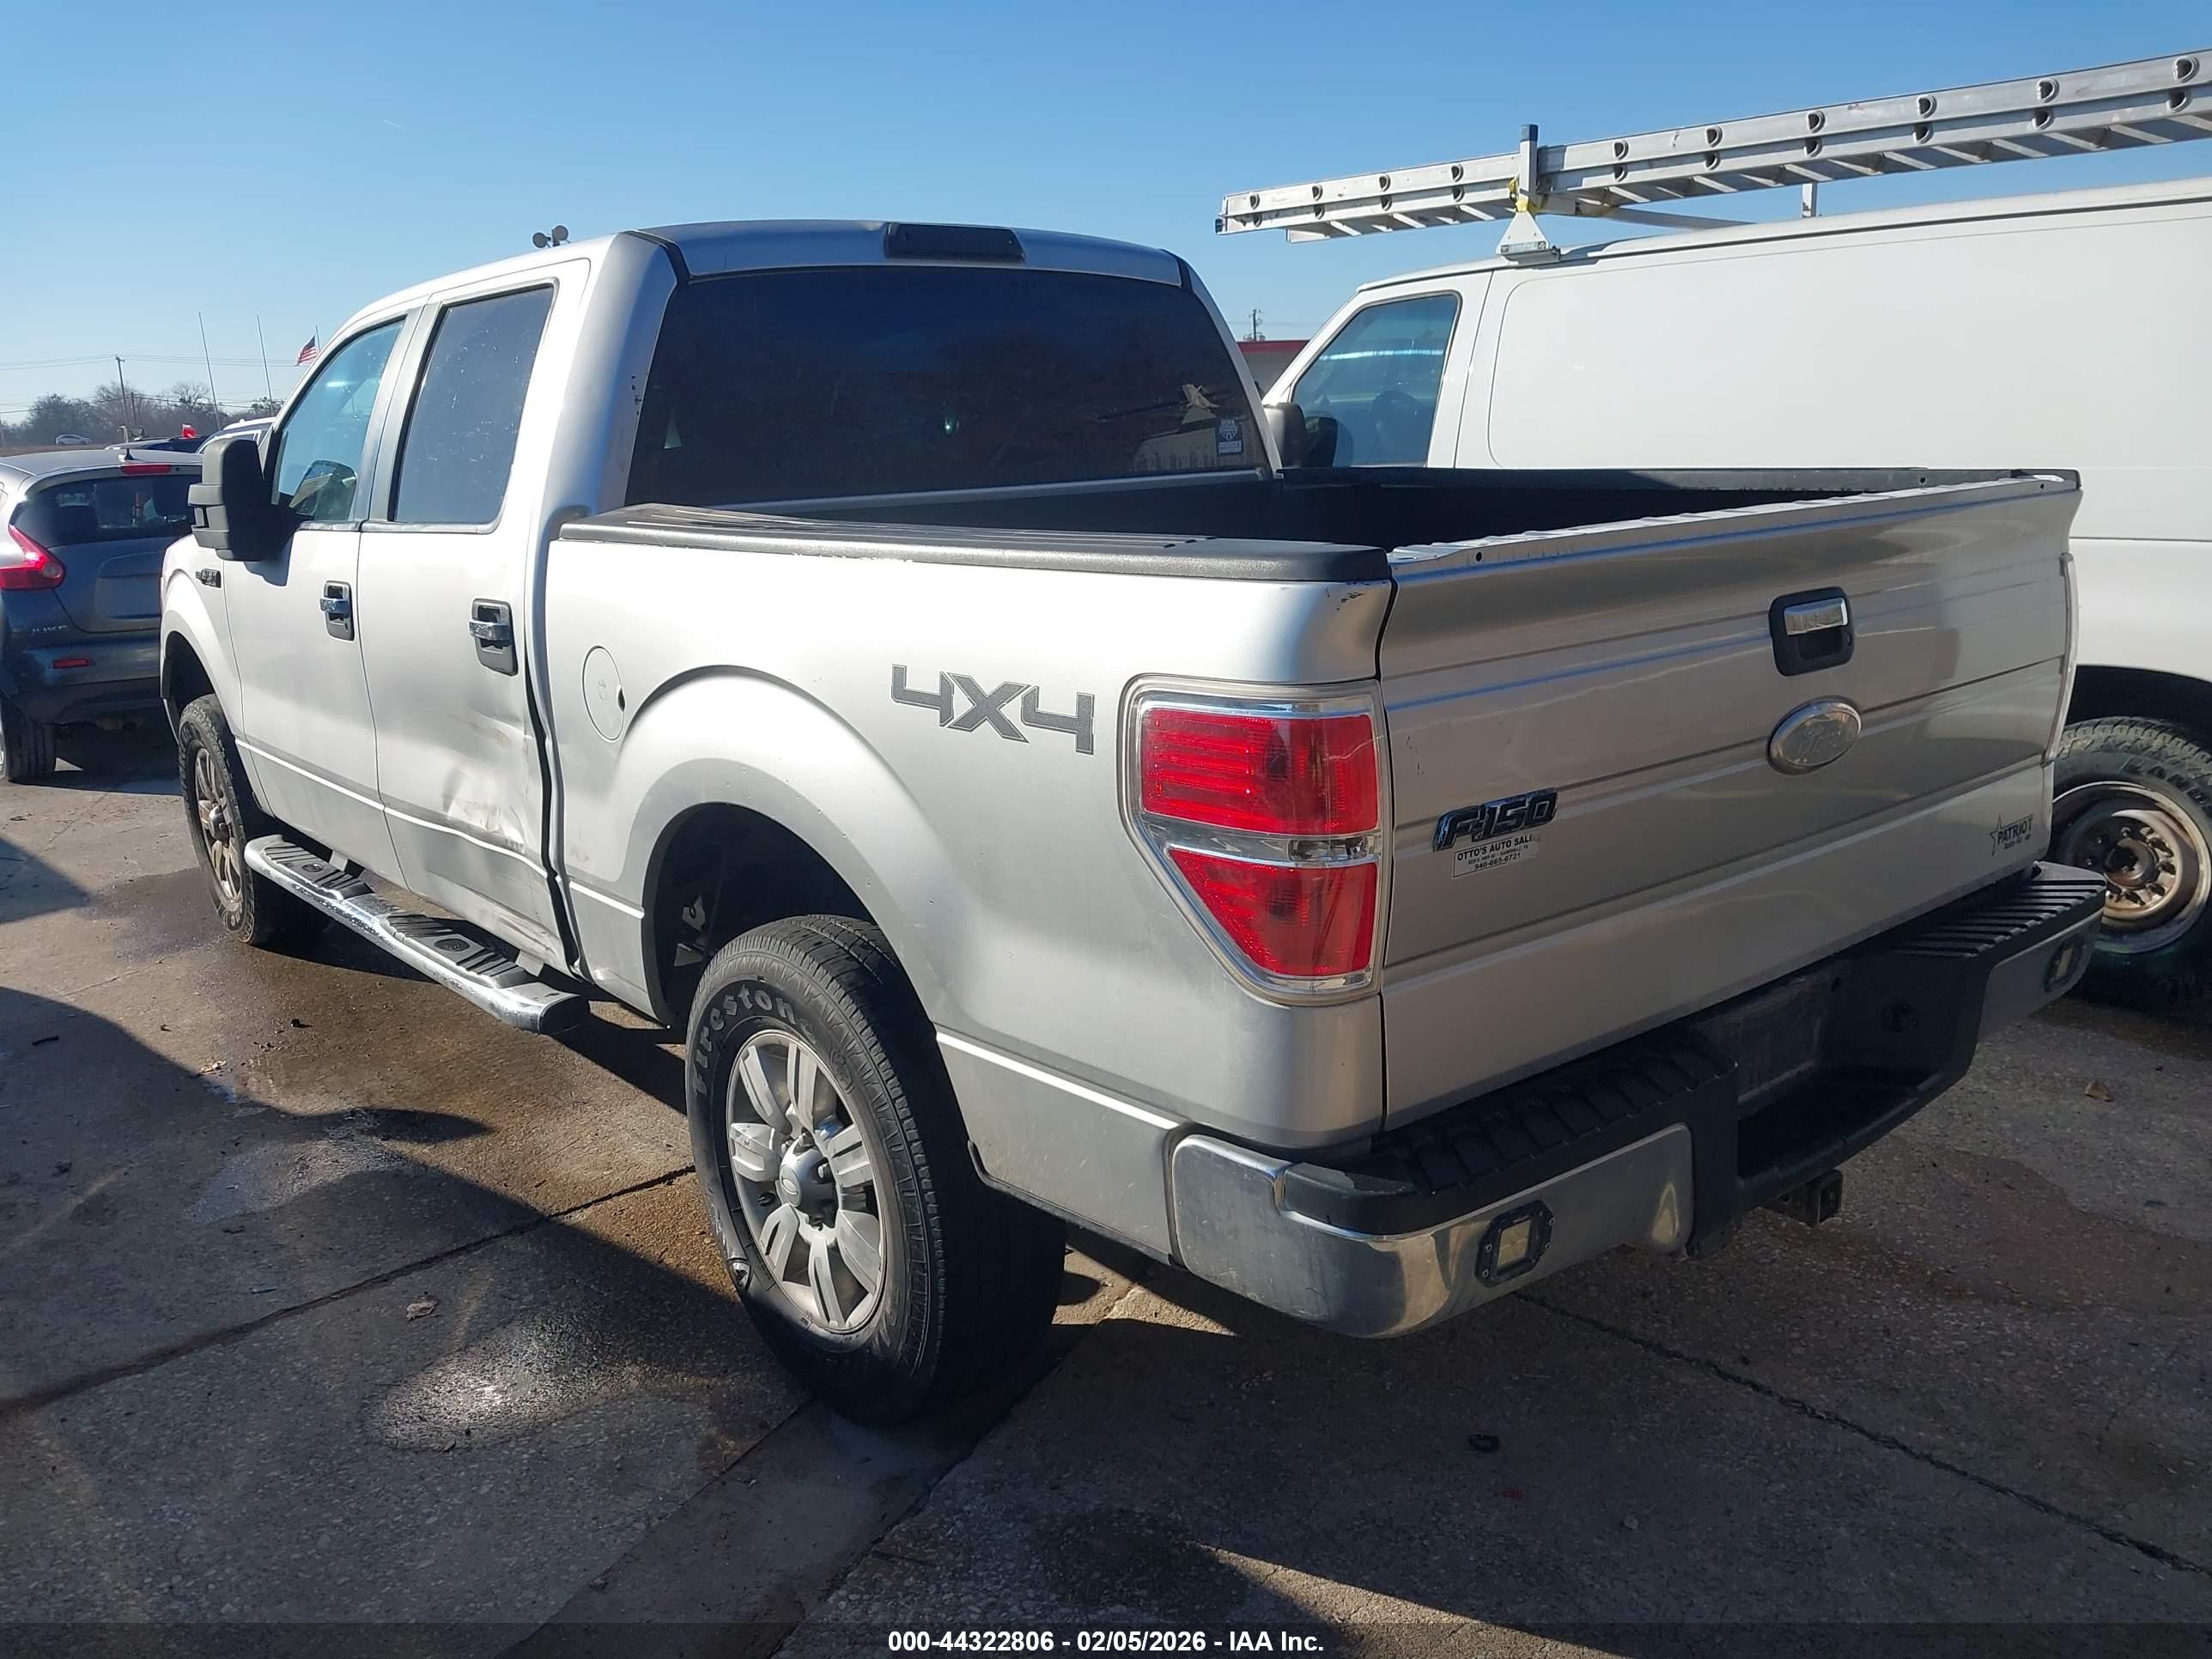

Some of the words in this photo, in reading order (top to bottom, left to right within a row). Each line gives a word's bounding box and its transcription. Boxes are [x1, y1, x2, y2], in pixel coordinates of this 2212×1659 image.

[1997, 817, 2033, 845] PATRIOT
[1457, 845, 1487, 861] OTTO'S
[1489, 840, 1511, 854] AUTO
